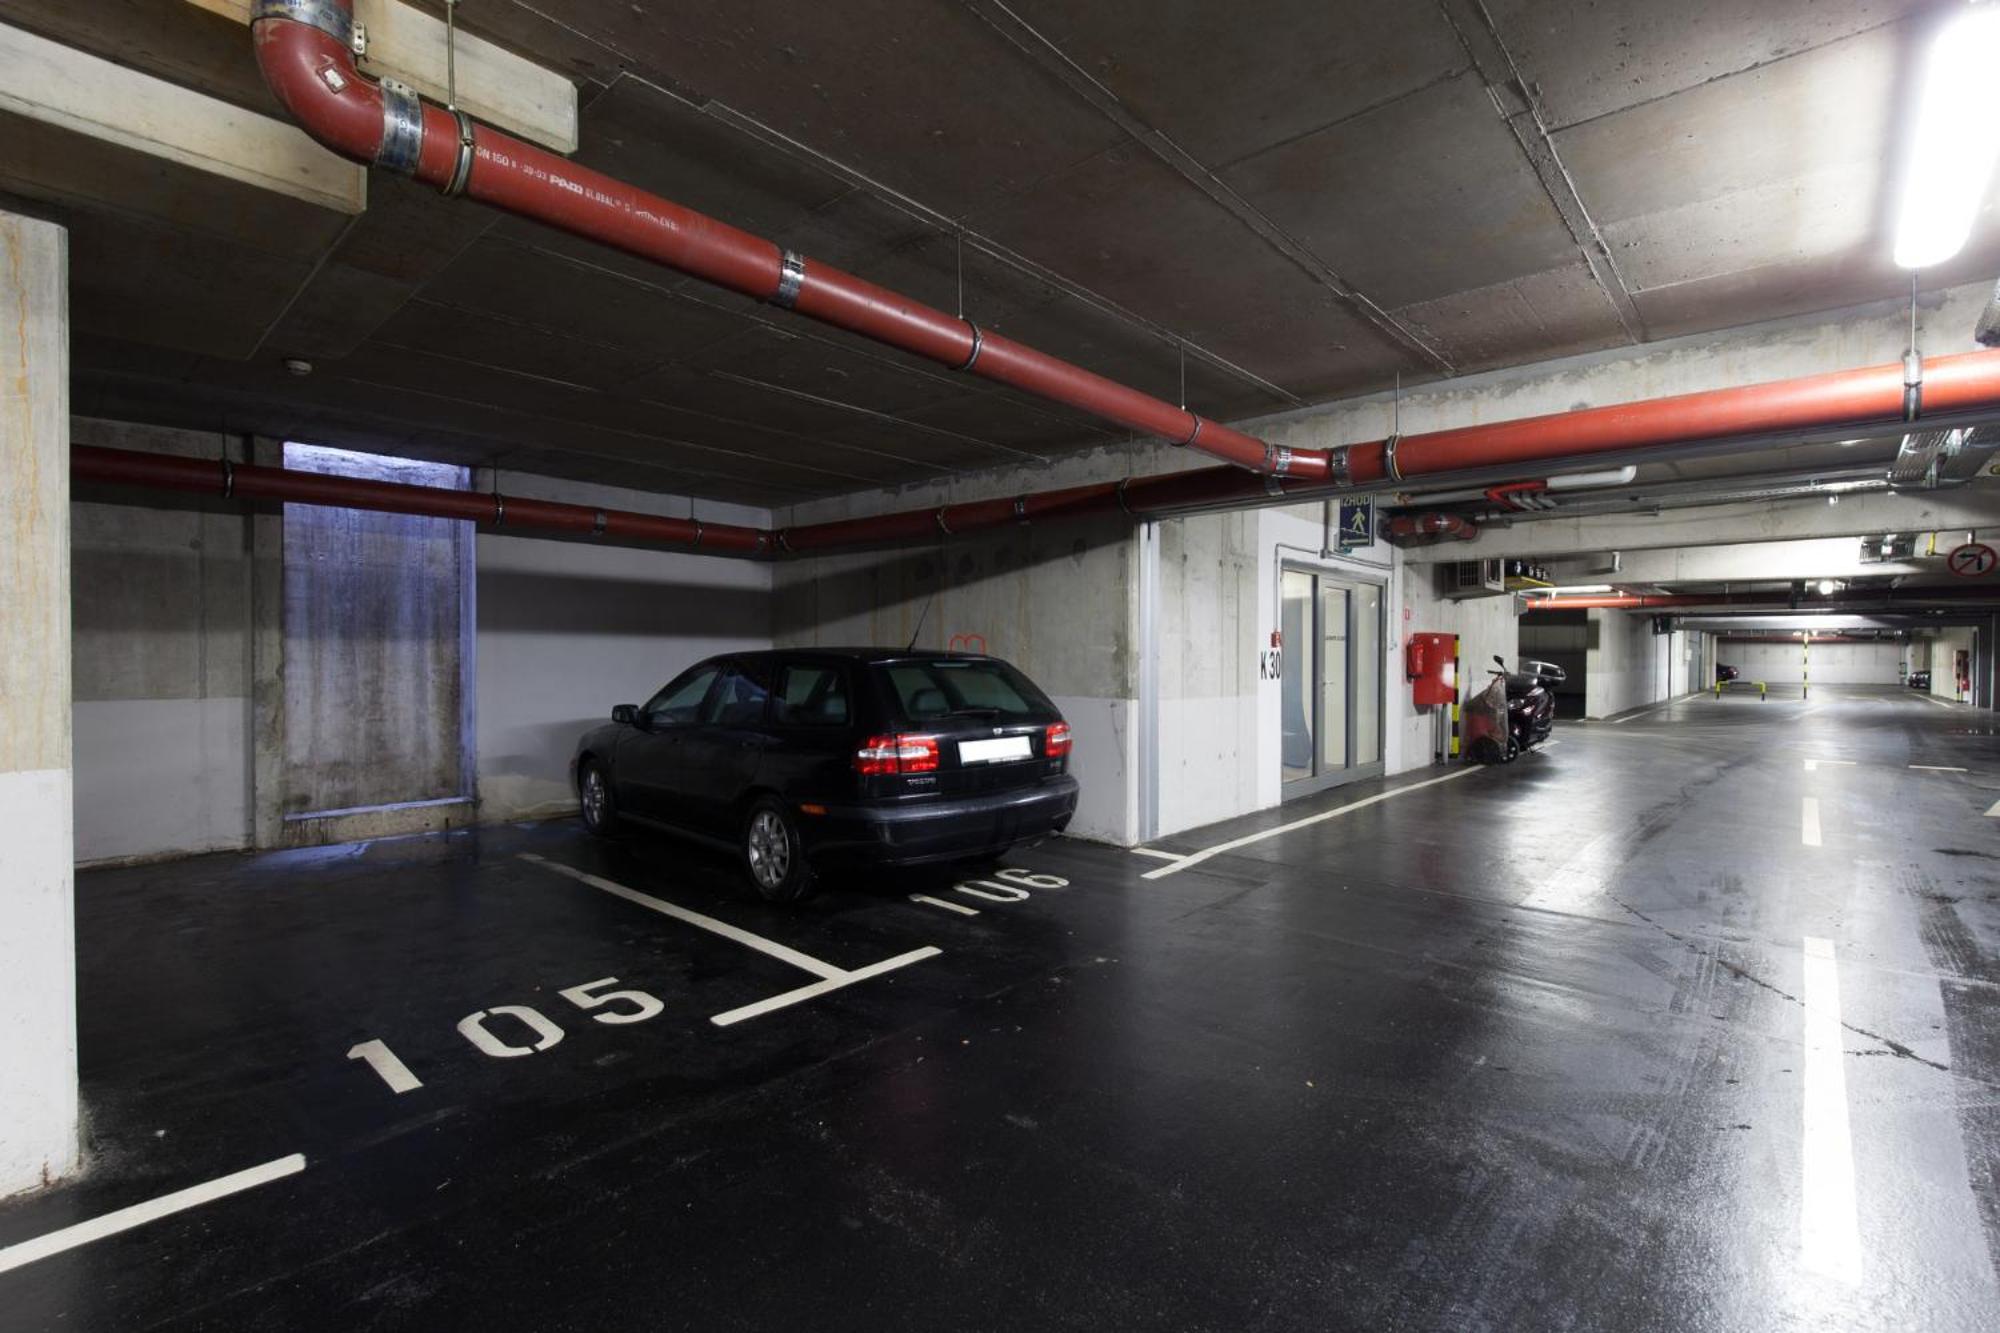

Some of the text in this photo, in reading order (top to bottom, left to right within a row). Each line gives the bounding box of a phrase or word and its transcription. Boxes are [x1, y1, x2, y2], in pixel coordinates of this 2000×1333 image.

[1340, 495, 1370, 508] IZHOD
[908, 867, 1070, 916] 106
[347, 976, 665, 1093] 105
